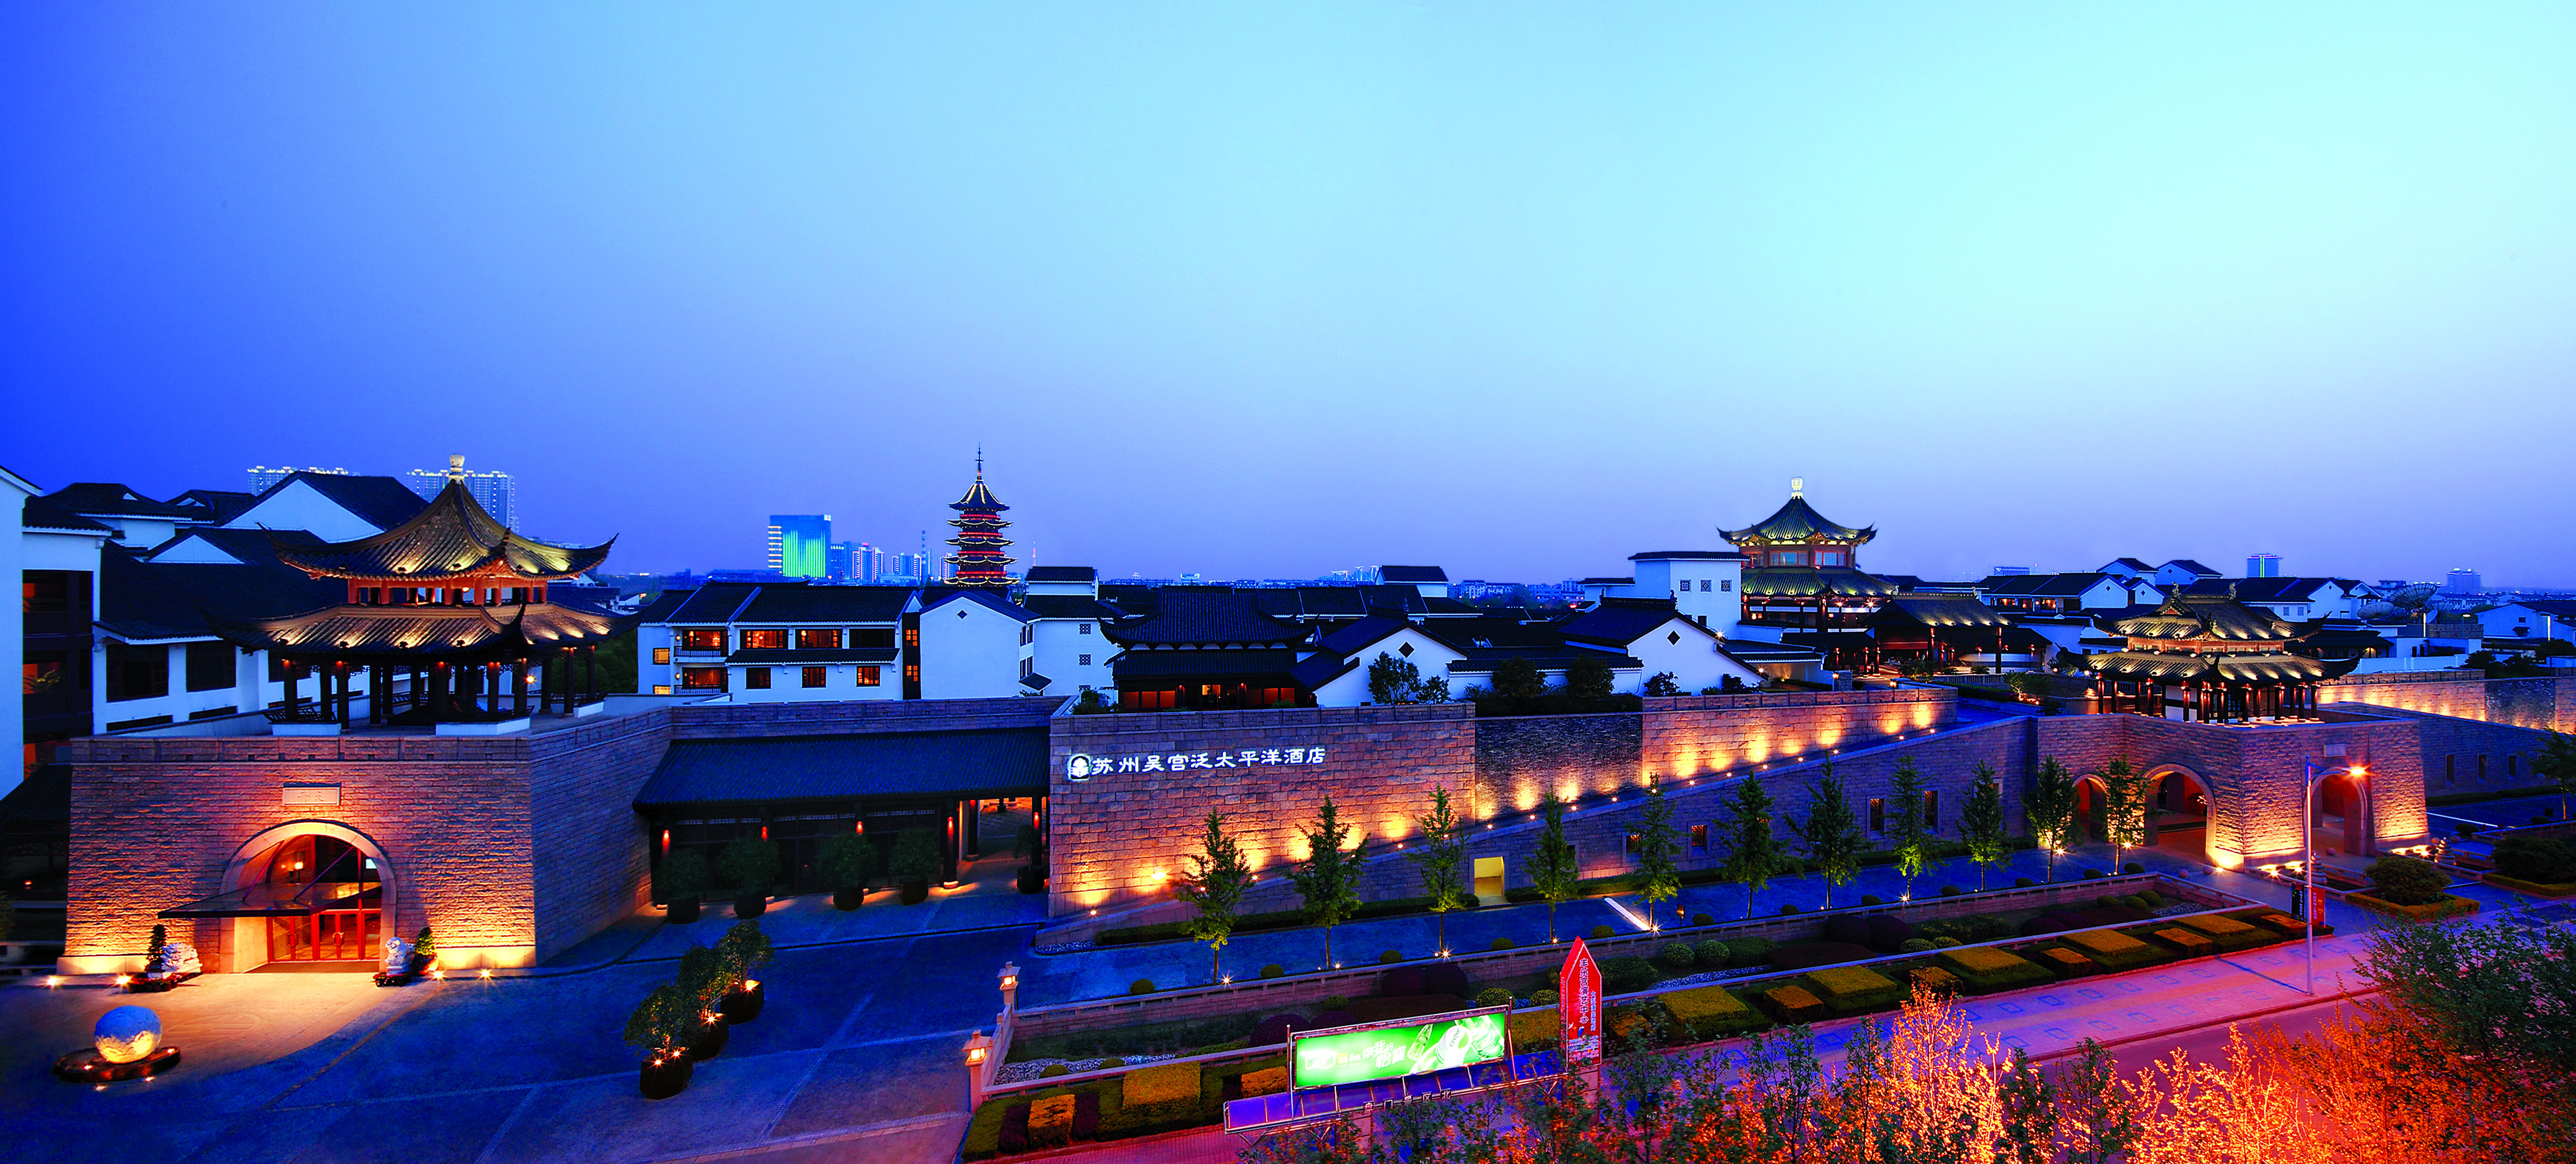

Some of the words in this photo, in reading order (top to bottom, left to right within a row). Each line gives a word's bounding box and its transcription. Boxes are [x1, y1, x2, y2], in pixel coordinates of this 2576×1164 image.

[1091, 747, 1325, 776] 苏州吴宫泛太平洋酒店
[1579, 958, 1589, 1024] 丰乐宫演艺中心
